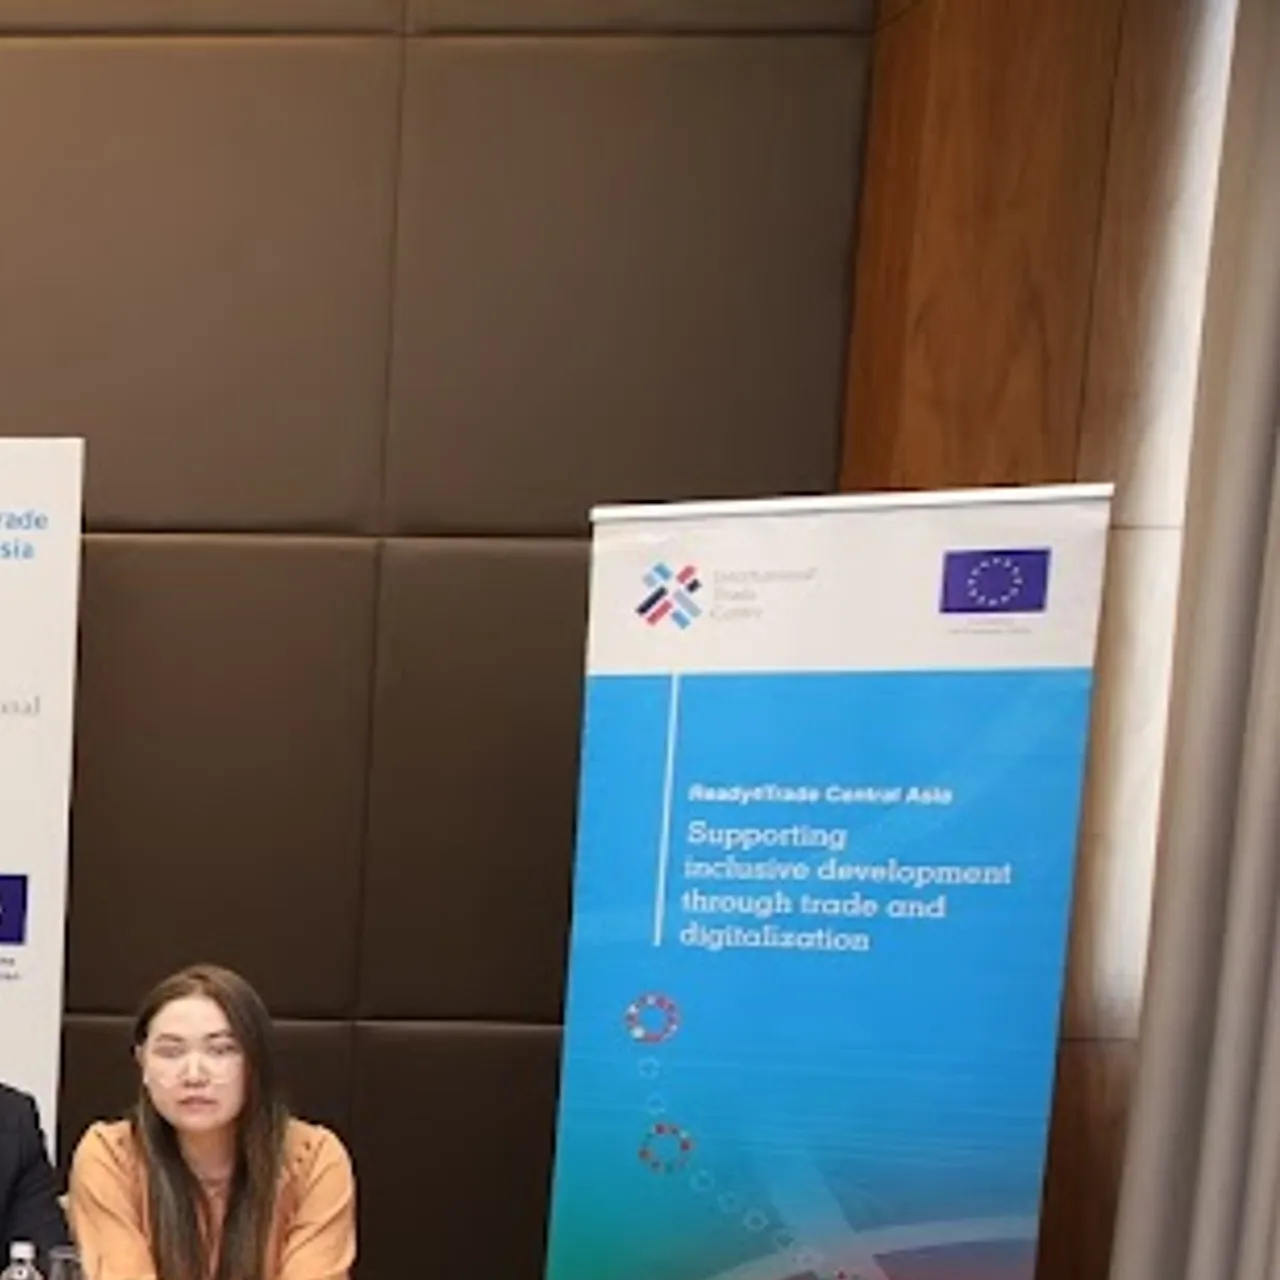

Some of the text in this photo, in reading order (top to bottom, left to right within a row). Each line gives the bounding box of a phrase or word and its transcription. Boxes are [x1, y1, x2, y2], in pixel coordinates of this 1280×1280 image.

[826, 786, 900, 803] Central
[906, 786, 952, 805] Asia
[687, 821, 847, 850] Supporting
[685, 857, 1011, 887] inclusive development
[682, 891, 945, 917] through trade and
